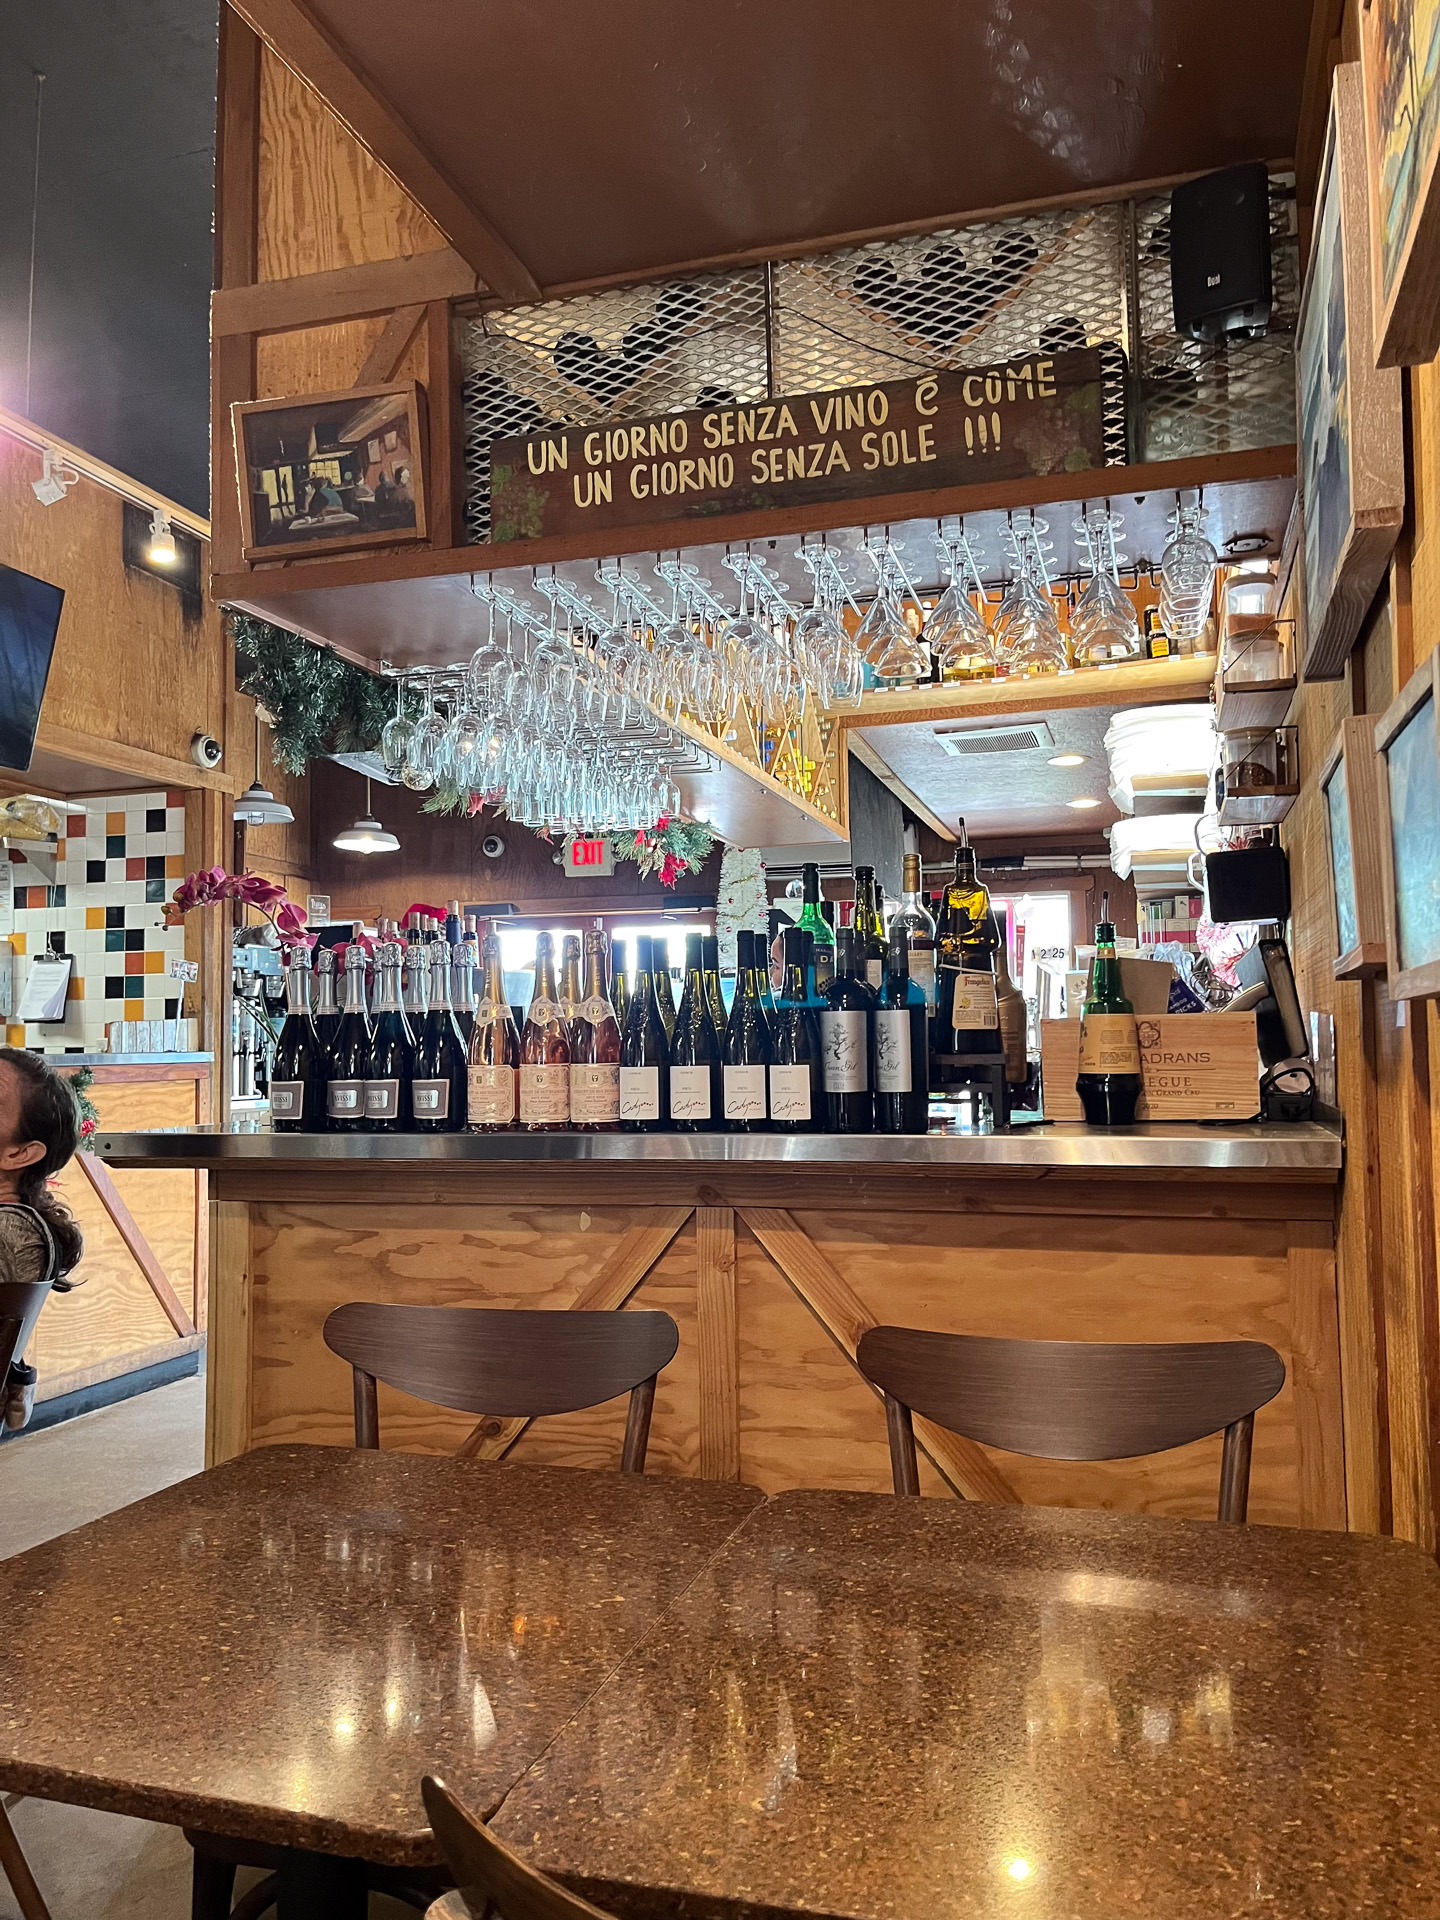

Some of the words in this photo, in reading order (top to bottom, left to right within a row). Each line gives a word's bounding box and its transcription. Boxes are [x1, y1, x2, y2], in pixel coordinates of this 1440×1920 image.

[527, 436, 568, 475] UN
[584, 418, 688, 466] GIORNO
[702, 404, 799, 449] SENZA
[809, 389, 889, 435] VINO
[962, 360, 1057, 407] COME
[573, 469, 613, 508] UN
[629, 452, 734, 499] GIORNO
[751, 439, 851, 484] SENZA
[861, 423, 937, 470] SOLE
[964, 411, 1001, 456] !!!
[572, 840, 605, 866] EXIT
[1148, 1077, 1192, 1088] EGUE
